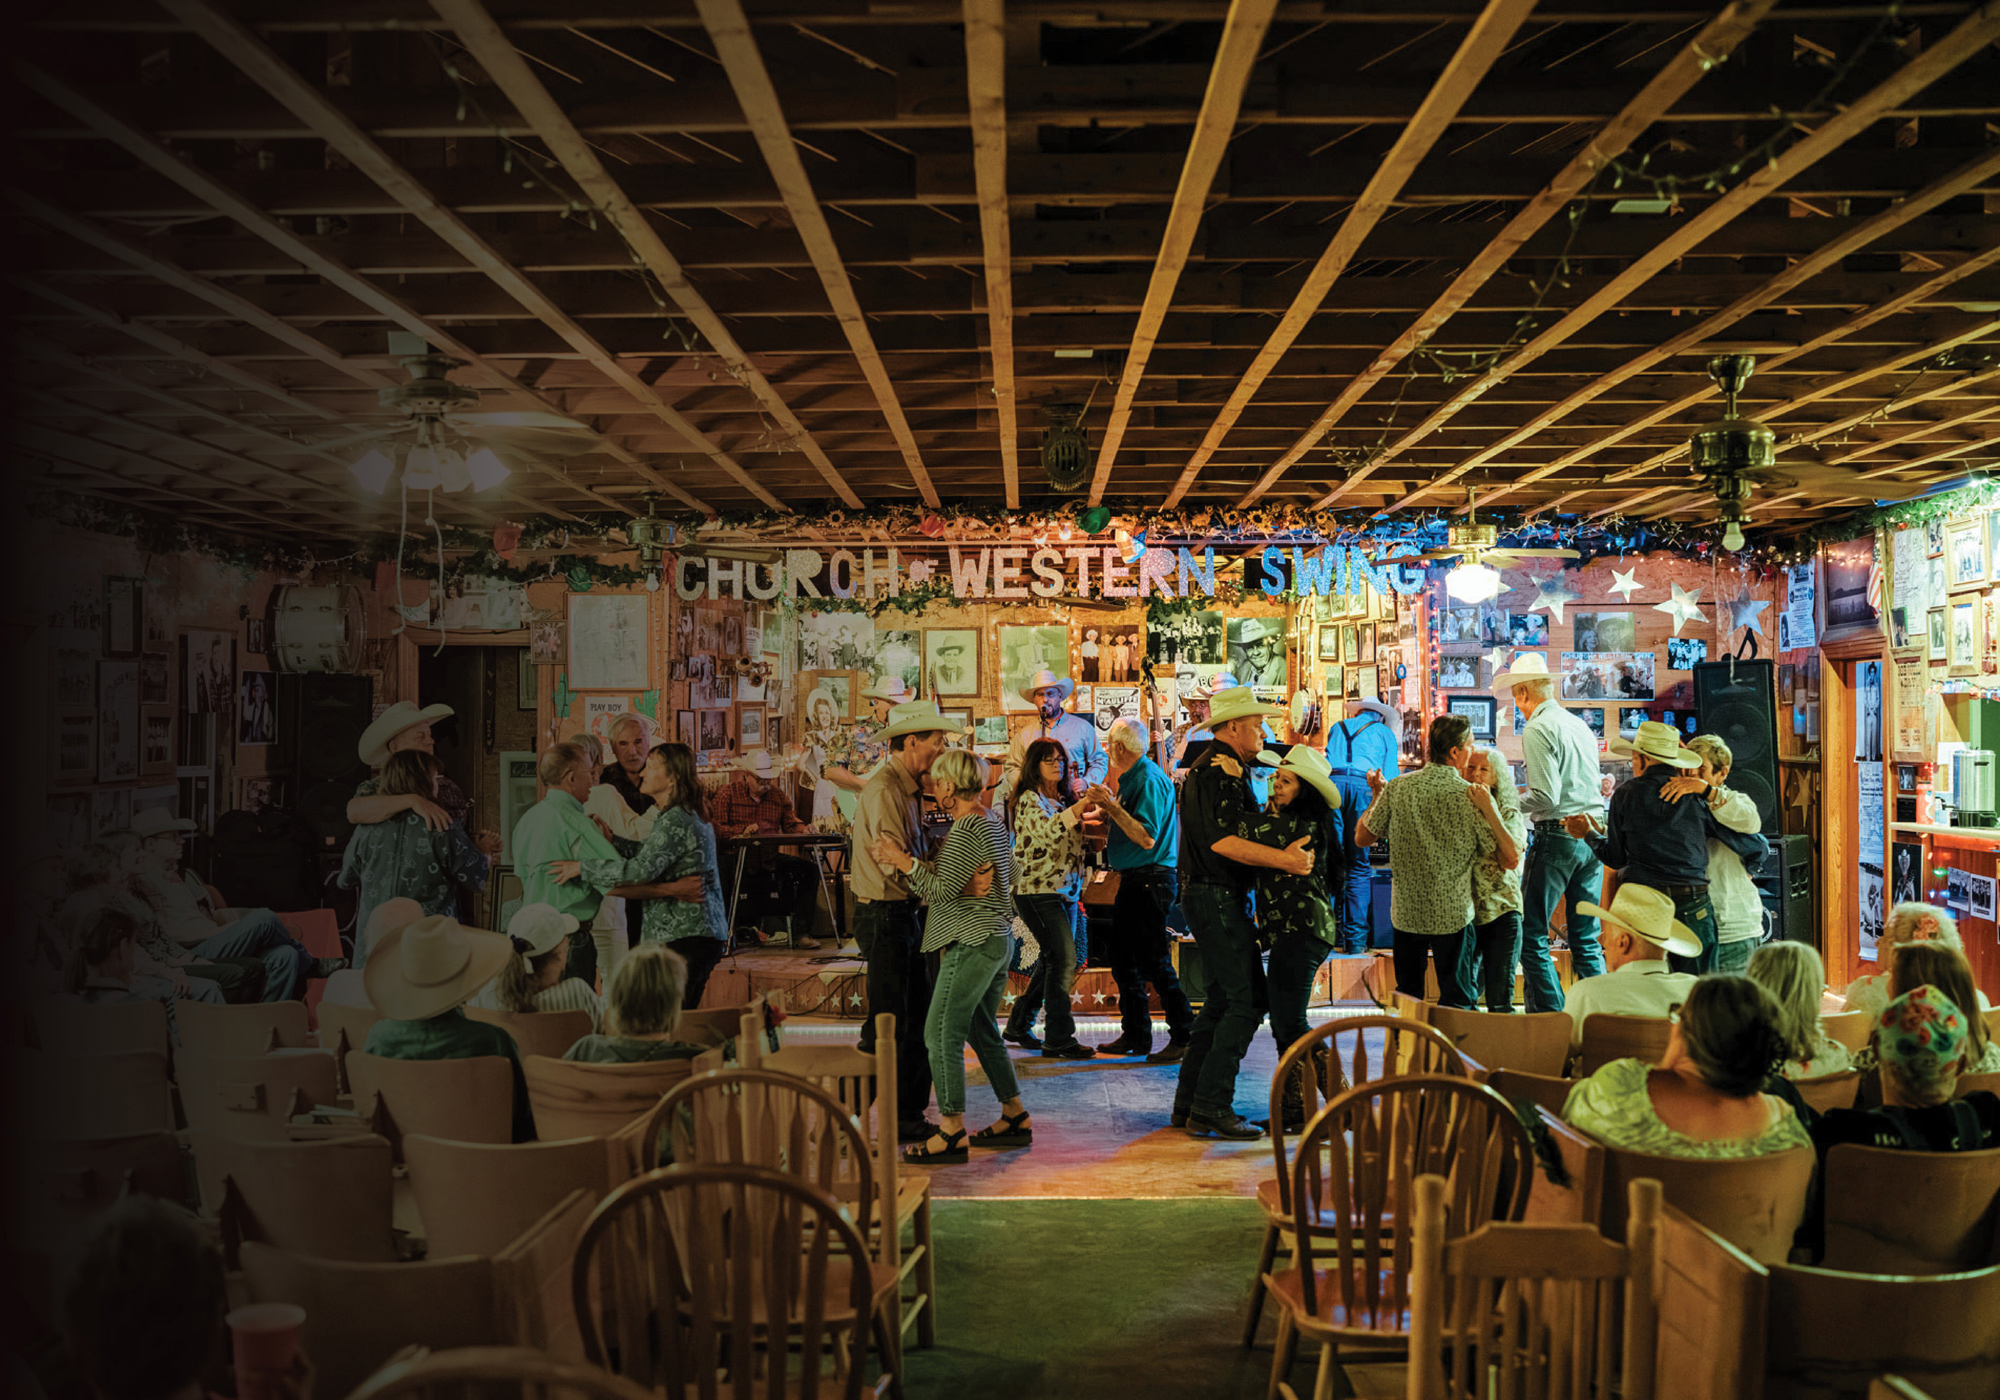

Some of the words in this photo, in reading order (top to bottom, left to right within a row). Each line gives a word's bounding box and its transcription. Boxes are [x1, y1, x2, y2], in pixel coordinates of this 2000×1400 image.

[675, 549, 898, 600] CHURCH
[909, 559, 939, 582] OF
[949, 546, 1215, 598] WESTERN
[1260, 543, 1426, 596] SWING
[590, 703, 606, 711] PLAY
[608, 703, 622, 711] BOY
